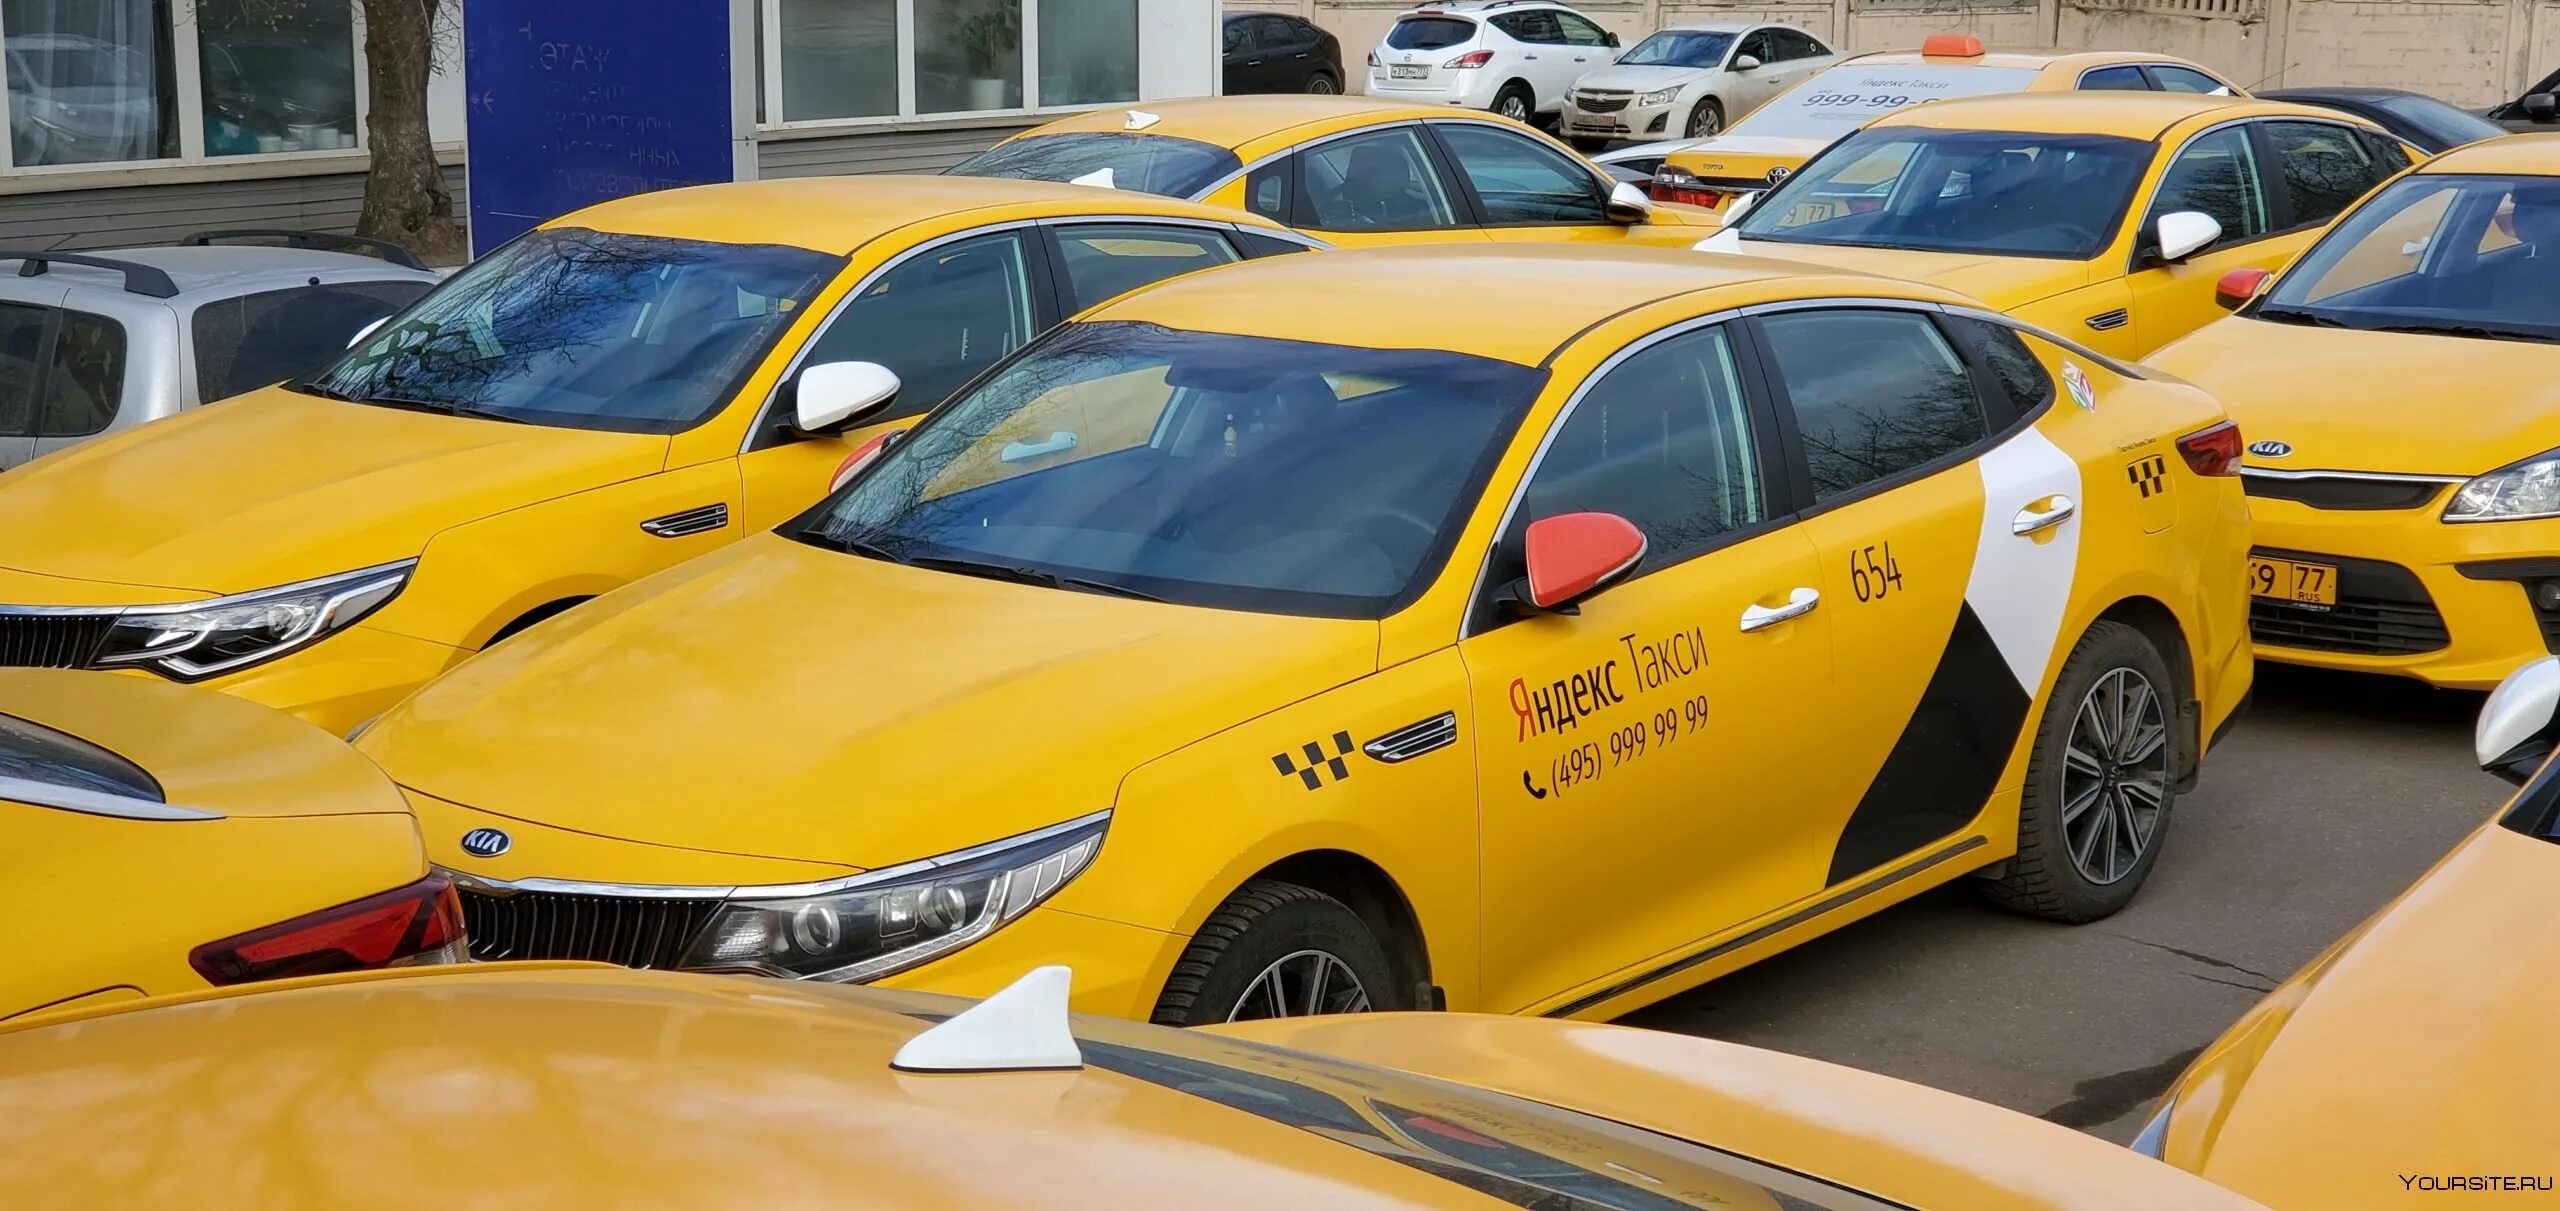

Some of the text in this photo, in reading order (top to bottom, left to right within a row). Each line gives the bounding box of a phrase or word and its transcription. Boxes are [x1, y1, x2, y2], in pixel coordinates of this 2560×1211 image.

[1803, 94, 1942, 108] 999-99-
[1809, 205, 1826, 220] 77
[2252, 442, 2285, 455] KIA
[1850, 541, 1903, 603] 654
[2295, 565, 2326, 592] 77
[2297, 591, 2321, 603] RUS
[1509, 626, 1709, 743] Яндекс Такси
[1551, 695, 1708, 798] (495) 999 99 99
[464, 830, 503, 853] KIA
